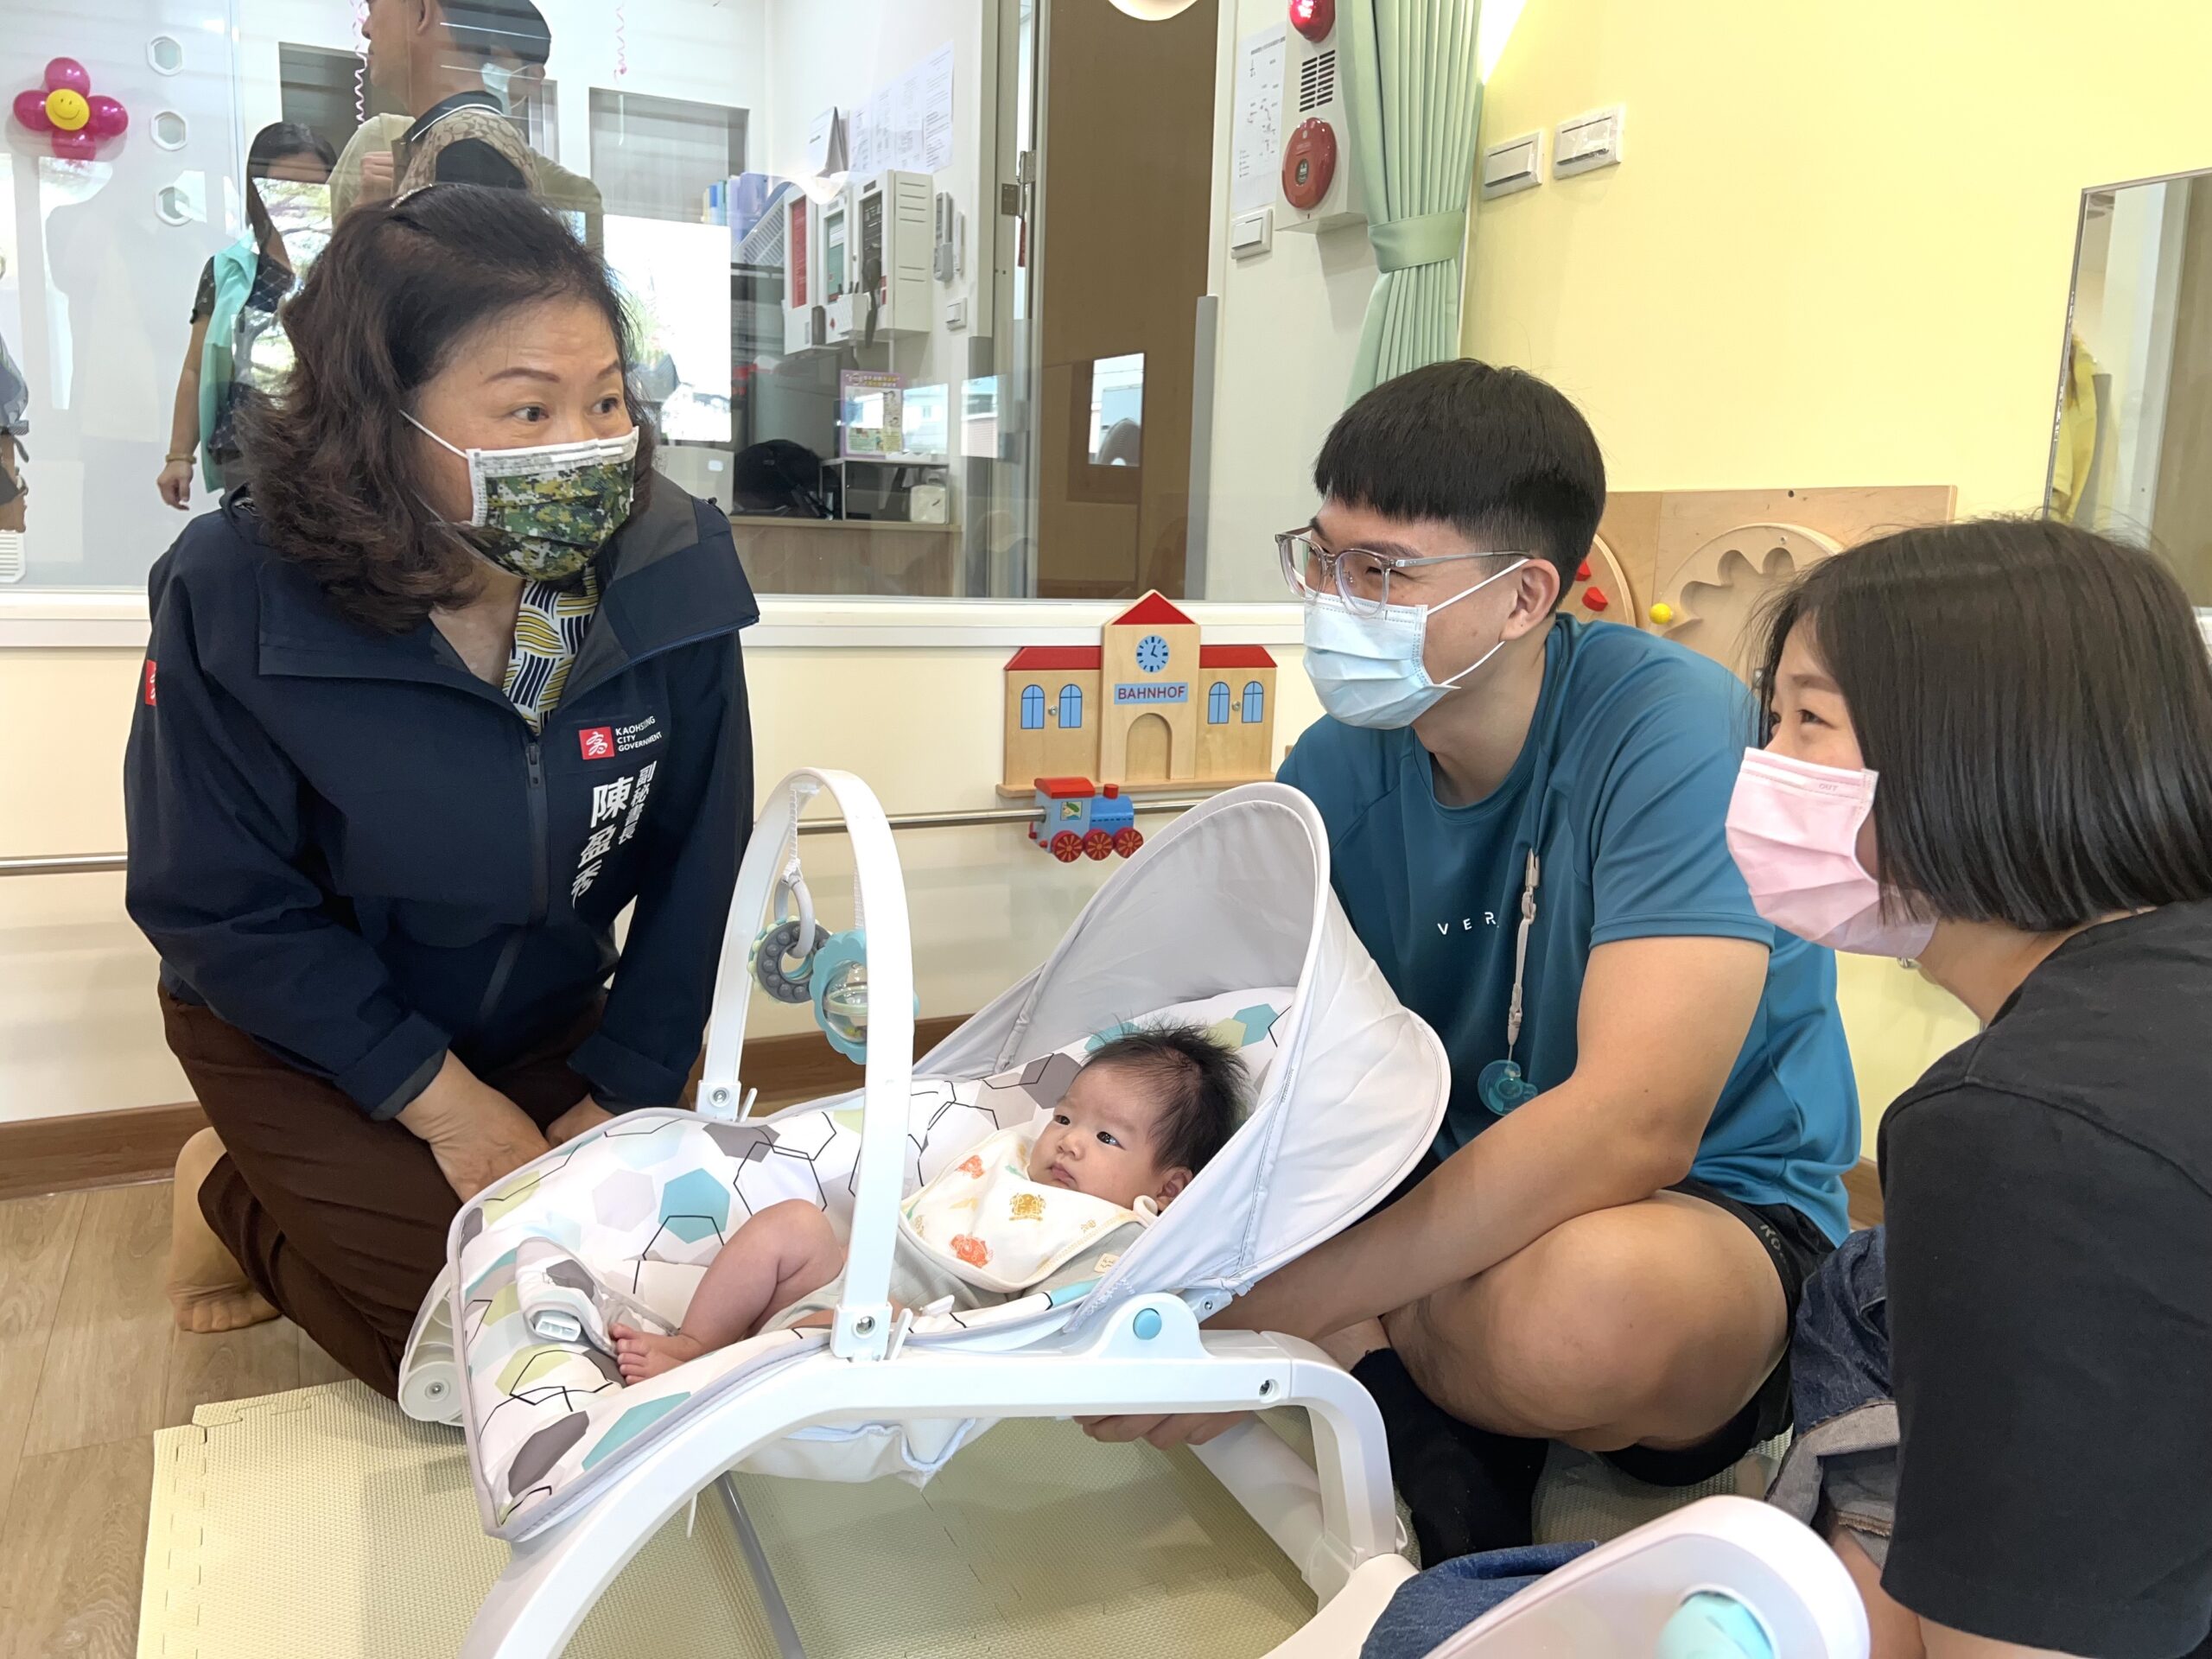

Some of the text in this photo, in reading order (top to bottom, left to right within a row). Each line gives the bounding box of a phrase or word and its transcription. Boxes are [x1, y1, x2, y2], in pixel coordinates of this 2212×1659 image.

[1118, 685, 1186, 701] BAHNHOF
[616, 734, 637, 745] CITY
[618, 731, 663, 753] GOVERNMENT
[1818, 783, 1840, 791] OUT
[1437, 911, 1500, 936] VER
